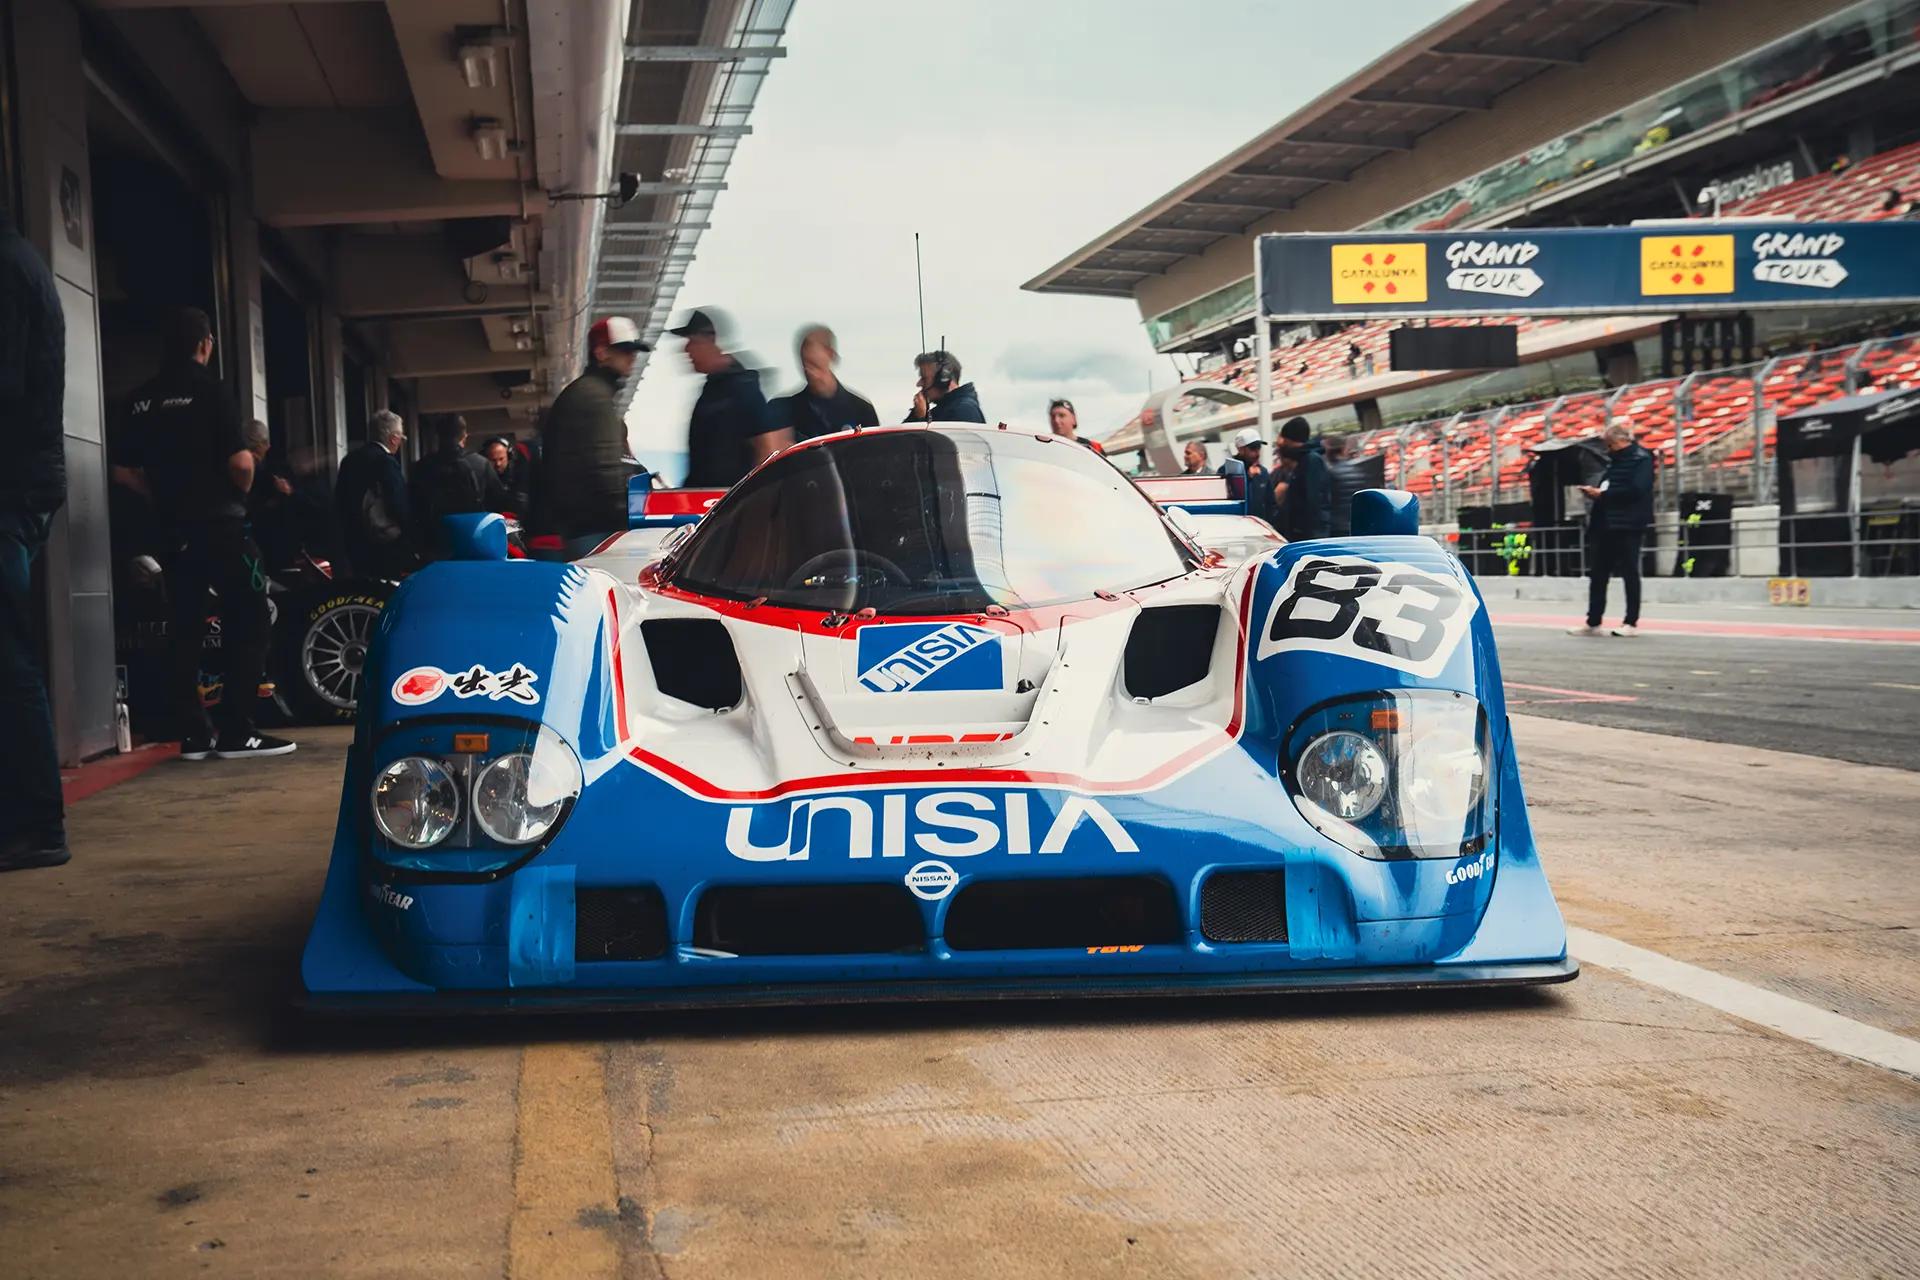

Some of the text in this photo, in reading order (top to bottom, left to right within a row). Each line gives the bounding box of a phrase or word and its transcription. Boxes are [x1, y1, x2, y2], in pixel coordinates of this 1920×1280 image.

[1446, 240, 1540, 268] GRAND
[1753, 232, 1845, 260] GRAND
[1341, 268, 1418, 279] CATALUNYA
[1650, 260, 1725, 271] CATALUNYA
[1765, 263, 1830, 282] TOUR
[1459, 271, 1526, 291] TOUR
[1269, 560, 1463, 662] 83
[454, 667, 534, 700] 出光
[1086, 945, 1145, 955] TOW
